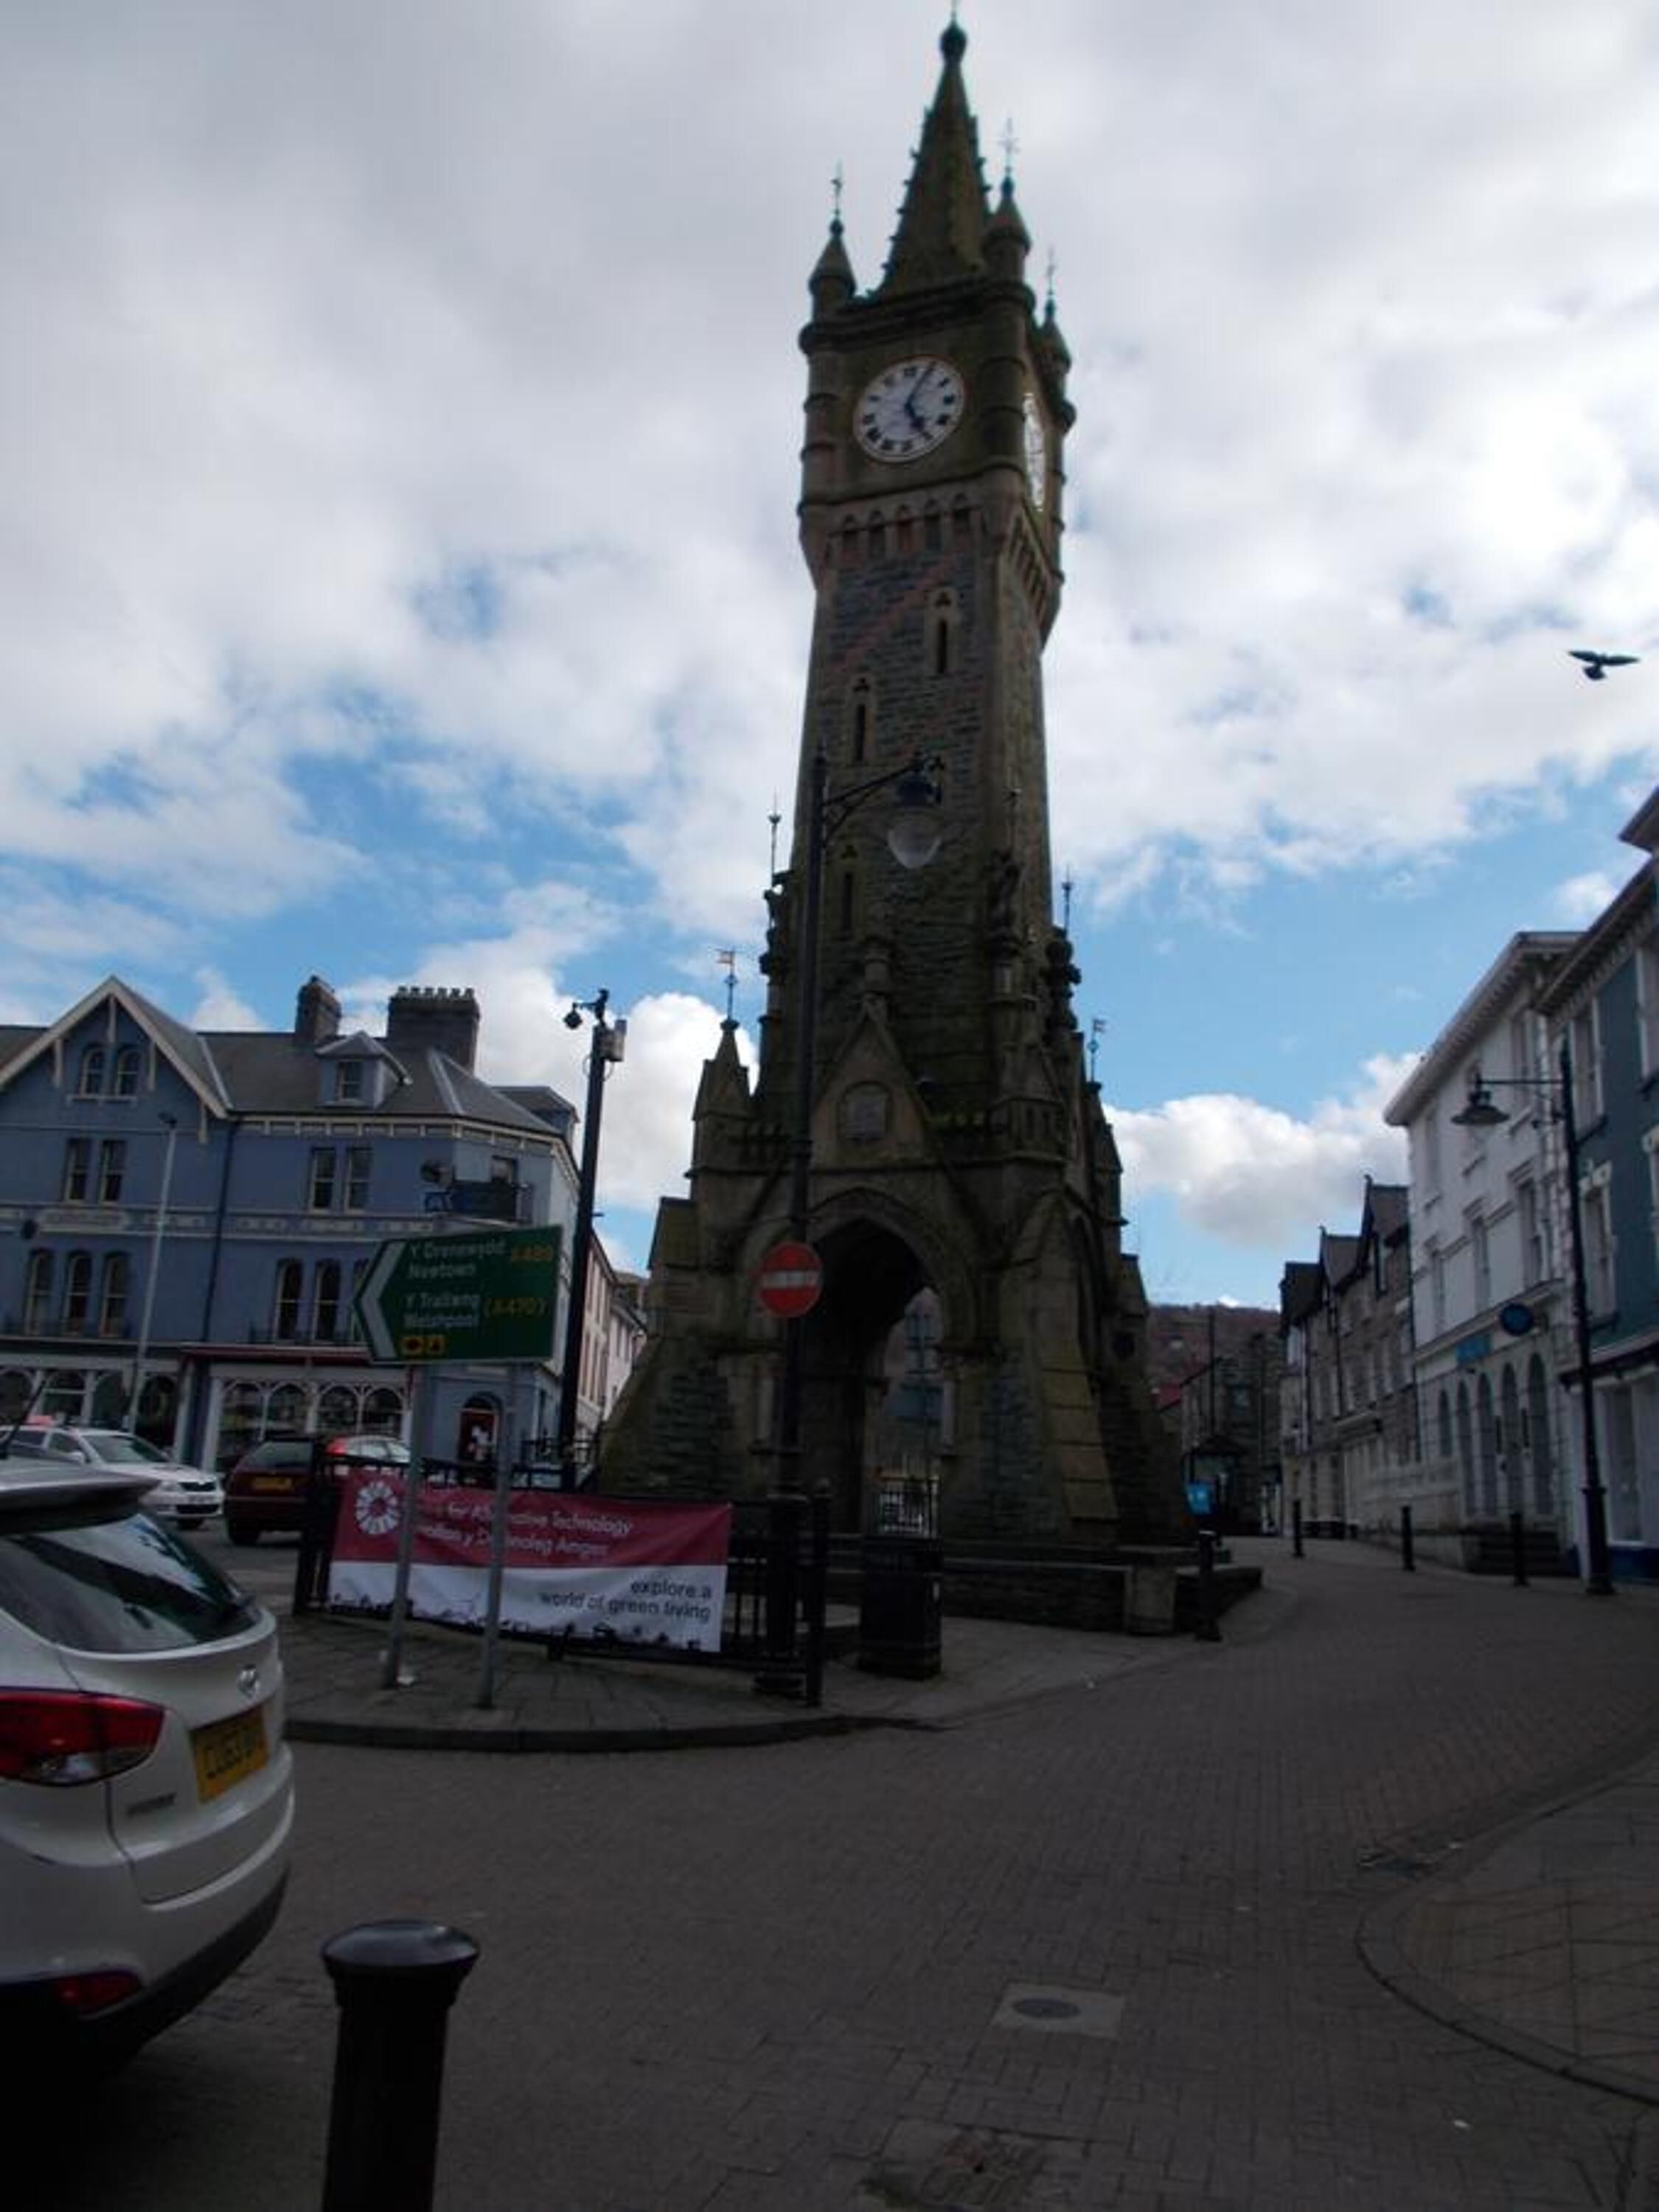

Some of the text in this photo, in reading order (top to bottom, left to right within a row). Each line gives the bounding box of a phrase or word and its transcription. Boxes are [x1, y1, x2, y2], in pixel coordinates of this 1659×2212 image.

[407, 1262, 476, 1281] Newtown
[552, 1511, 631, 1537] Technology
[630, 1577, 696, 1599] explore
[540, 1590, 585, 1607] world
[608, 1598, 659, 1616] green
[664, 1601, 711, 1624] living
